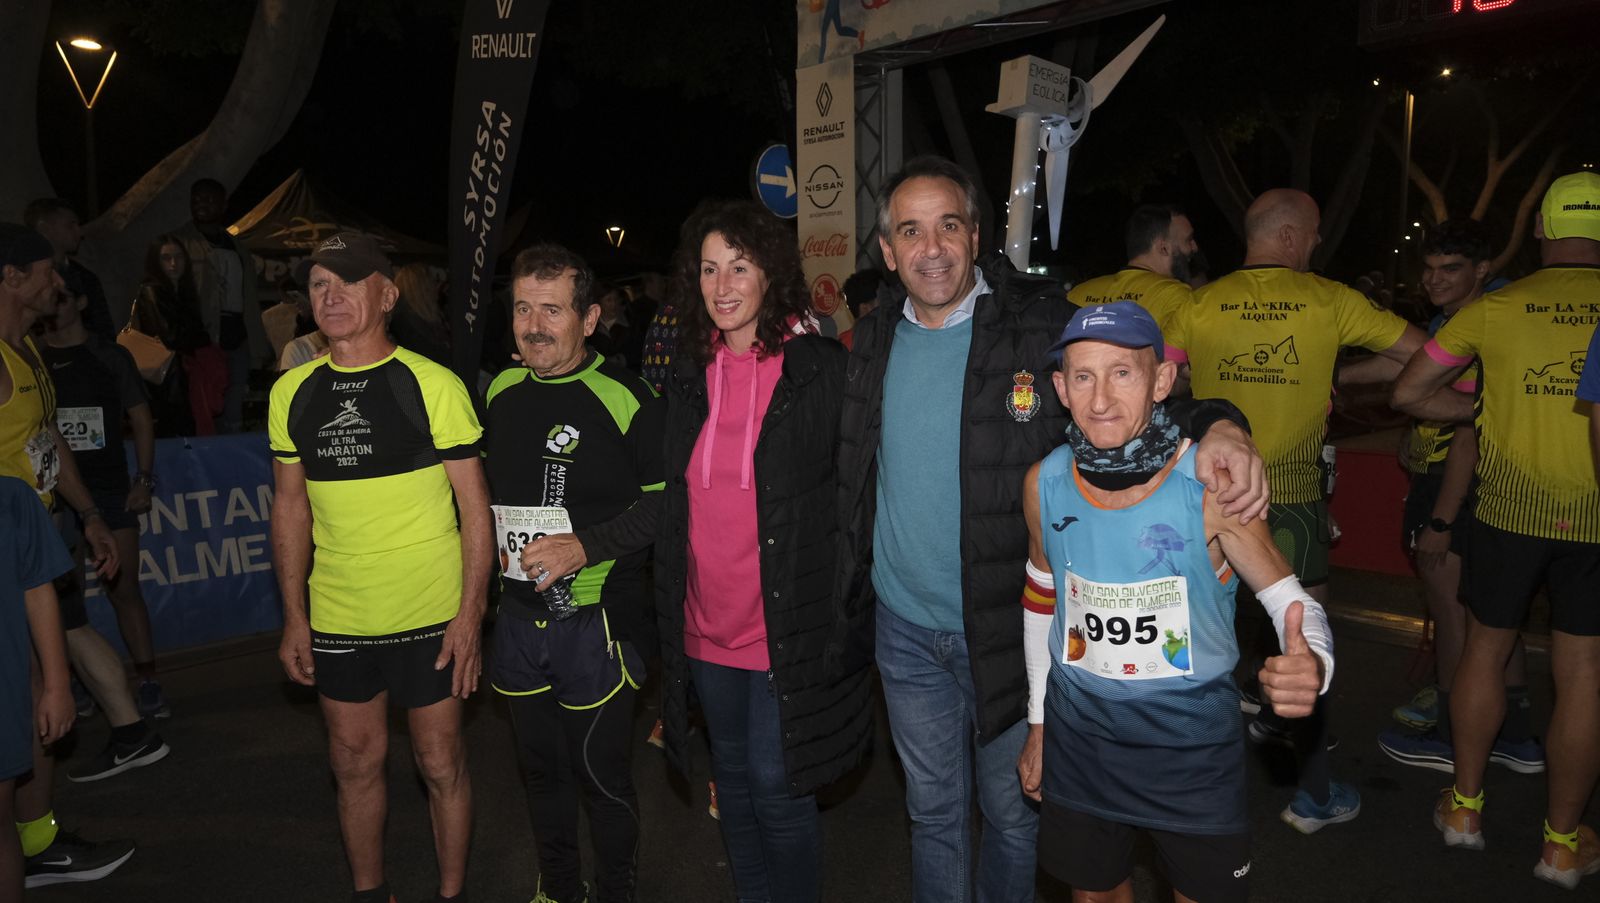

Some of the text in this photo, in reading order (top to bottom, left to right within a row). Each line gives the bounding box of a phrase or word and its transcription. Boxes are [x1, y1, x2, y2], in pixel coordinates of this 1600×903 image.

[471, 33, 537, 59] RENAULT
[803, 121, 846, 138] RENAULT
[463, 100, 497, 232] SYRSA
[804, 181, 844, 193] NISSAN
[464, 111, 514, 333] AUTOMOCIÓN
[1221, 303, 1240, 312] Bar
[1243, 301, 1259, 311] LA
[1525, 303, 1551, 314] Bar
[1555, 303, 1575, 313] LA
[1239, 312, 1288, 323] ALQUIAN
[1237, 365, 1284, 374] Excavaciones
[332, 379, 369, 391] land
[1220, 371, 1230, 381] El
[1233, 372, 1287, 385] Manolillo
[1525, 384, 1538, 395] El
[331, 435, 357, 446] ULTRA
[317, 444, 373, 458] MARATON
[336, 456, 359, 467] 2022
[555, 464, 567, 497] AUTOS
[1082, 580, 1178, 598] XIV SAN SILVESTRE
[1083, 591, 1182, 609] CIUDAD DE ALMERIA
[1084, 612, 1159, 646] 995
